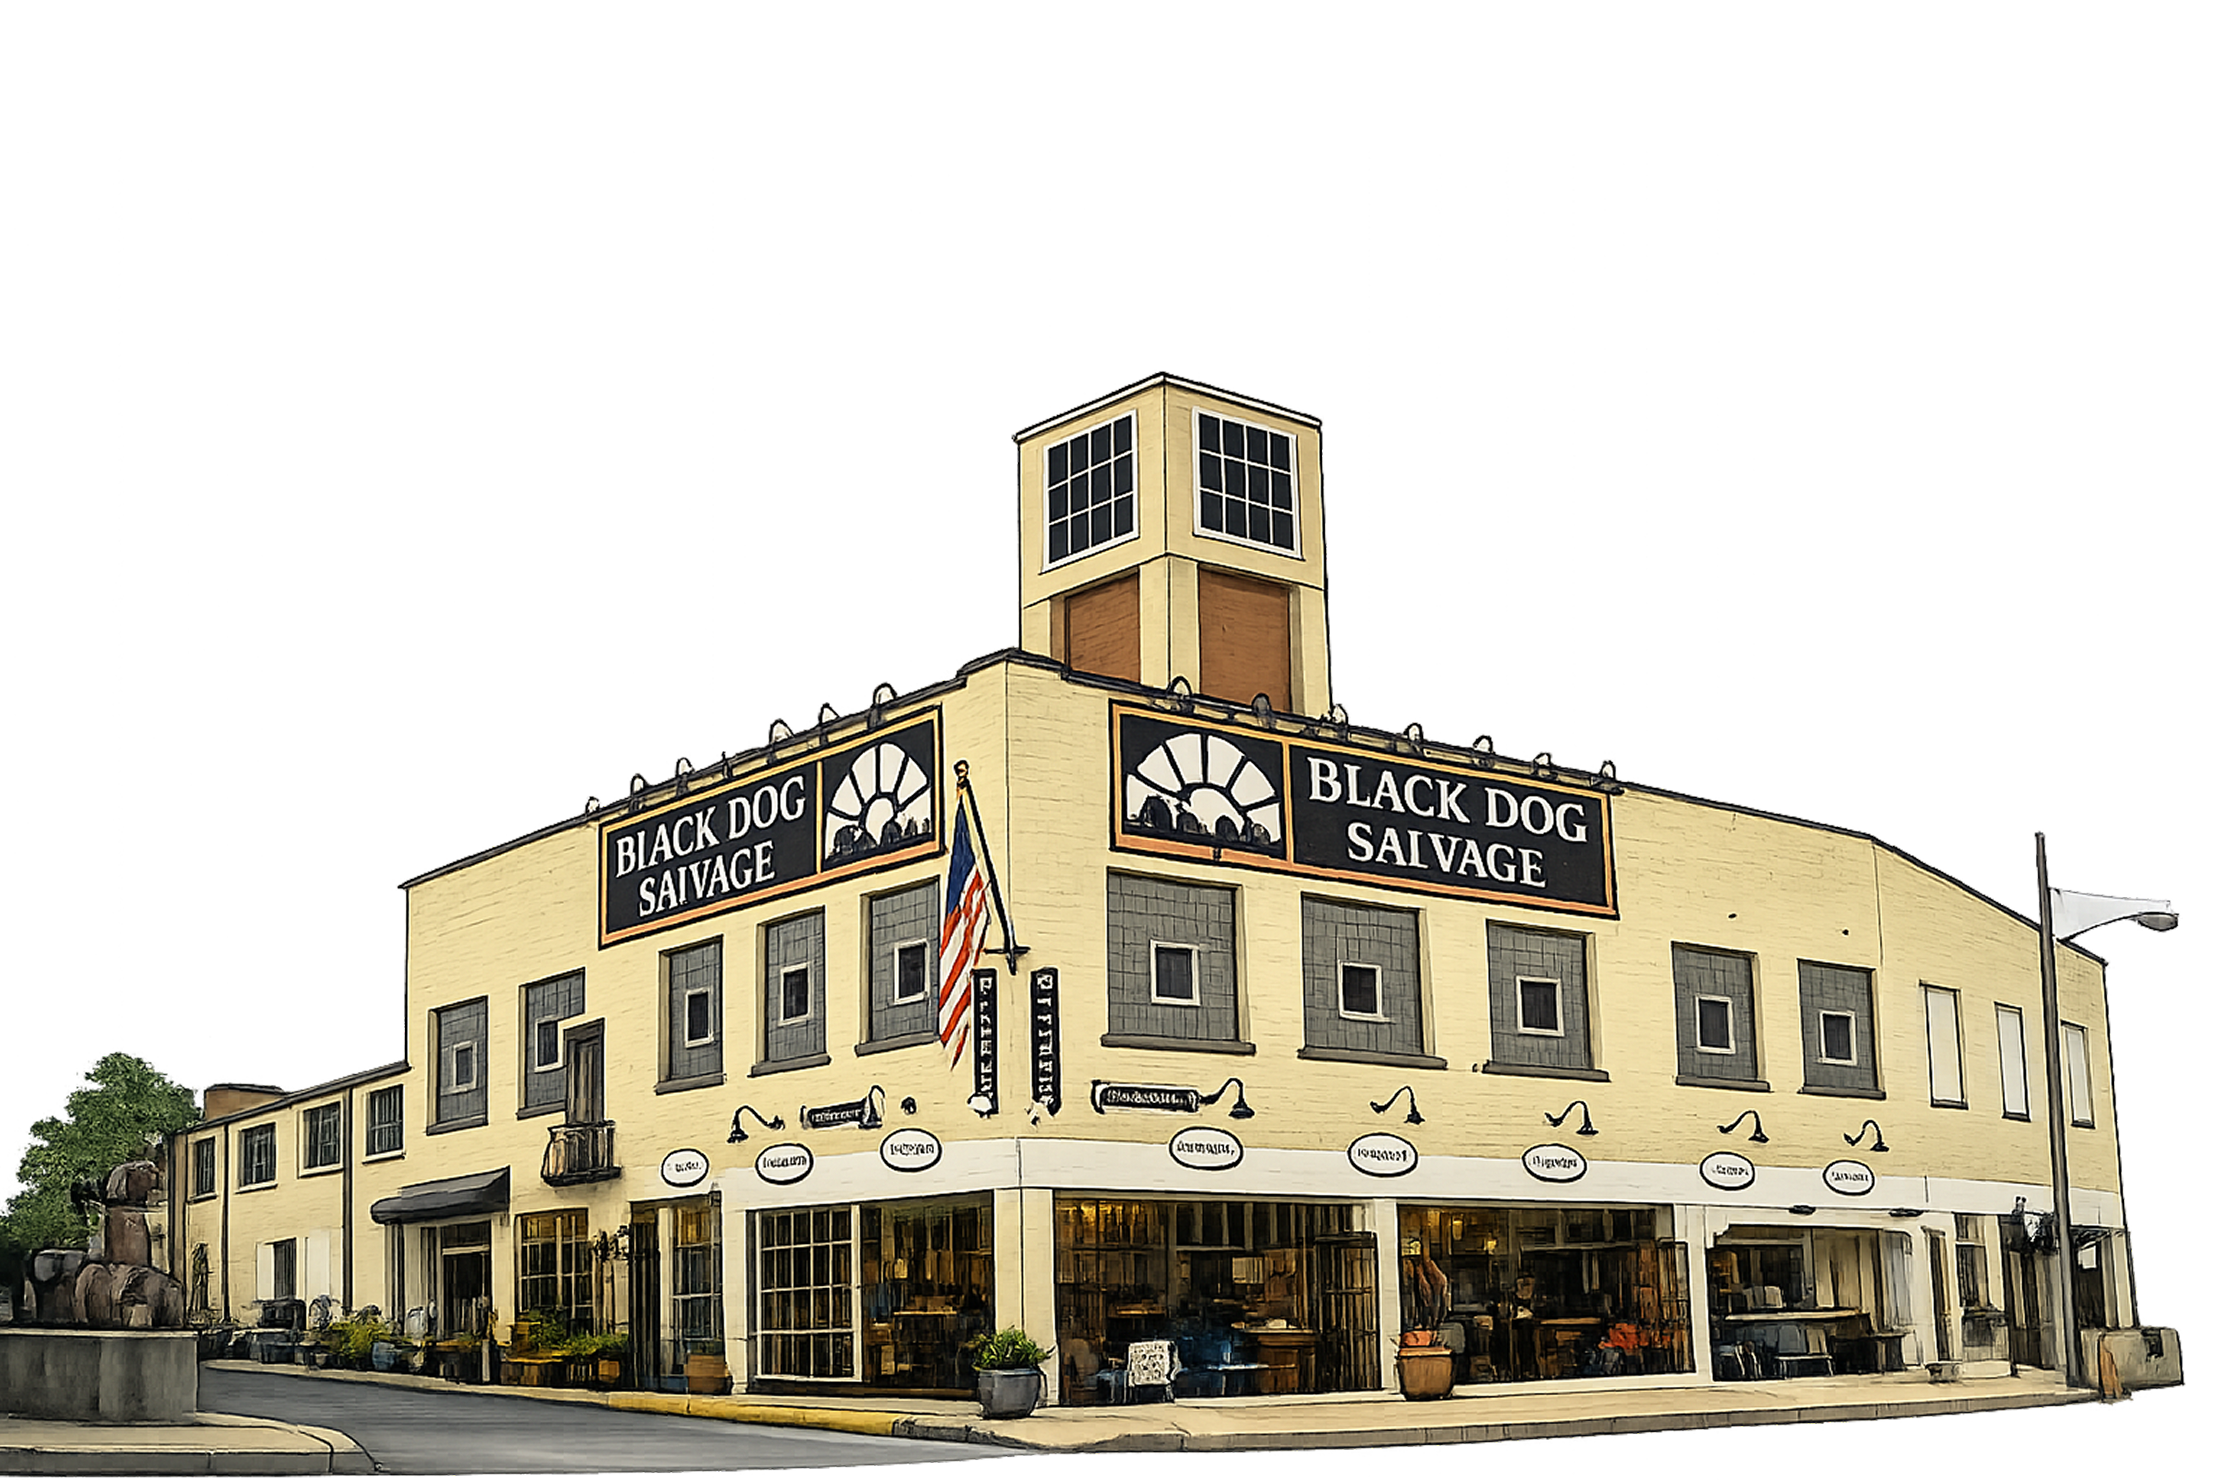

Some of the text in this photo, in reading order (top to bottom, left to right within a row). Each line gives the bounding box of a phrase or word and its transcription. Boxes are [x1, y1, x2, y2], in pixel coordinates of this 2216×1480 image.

[727, 775, 807, 840] DOG
[1306, 756, 1588, 843] BLACK DOG
